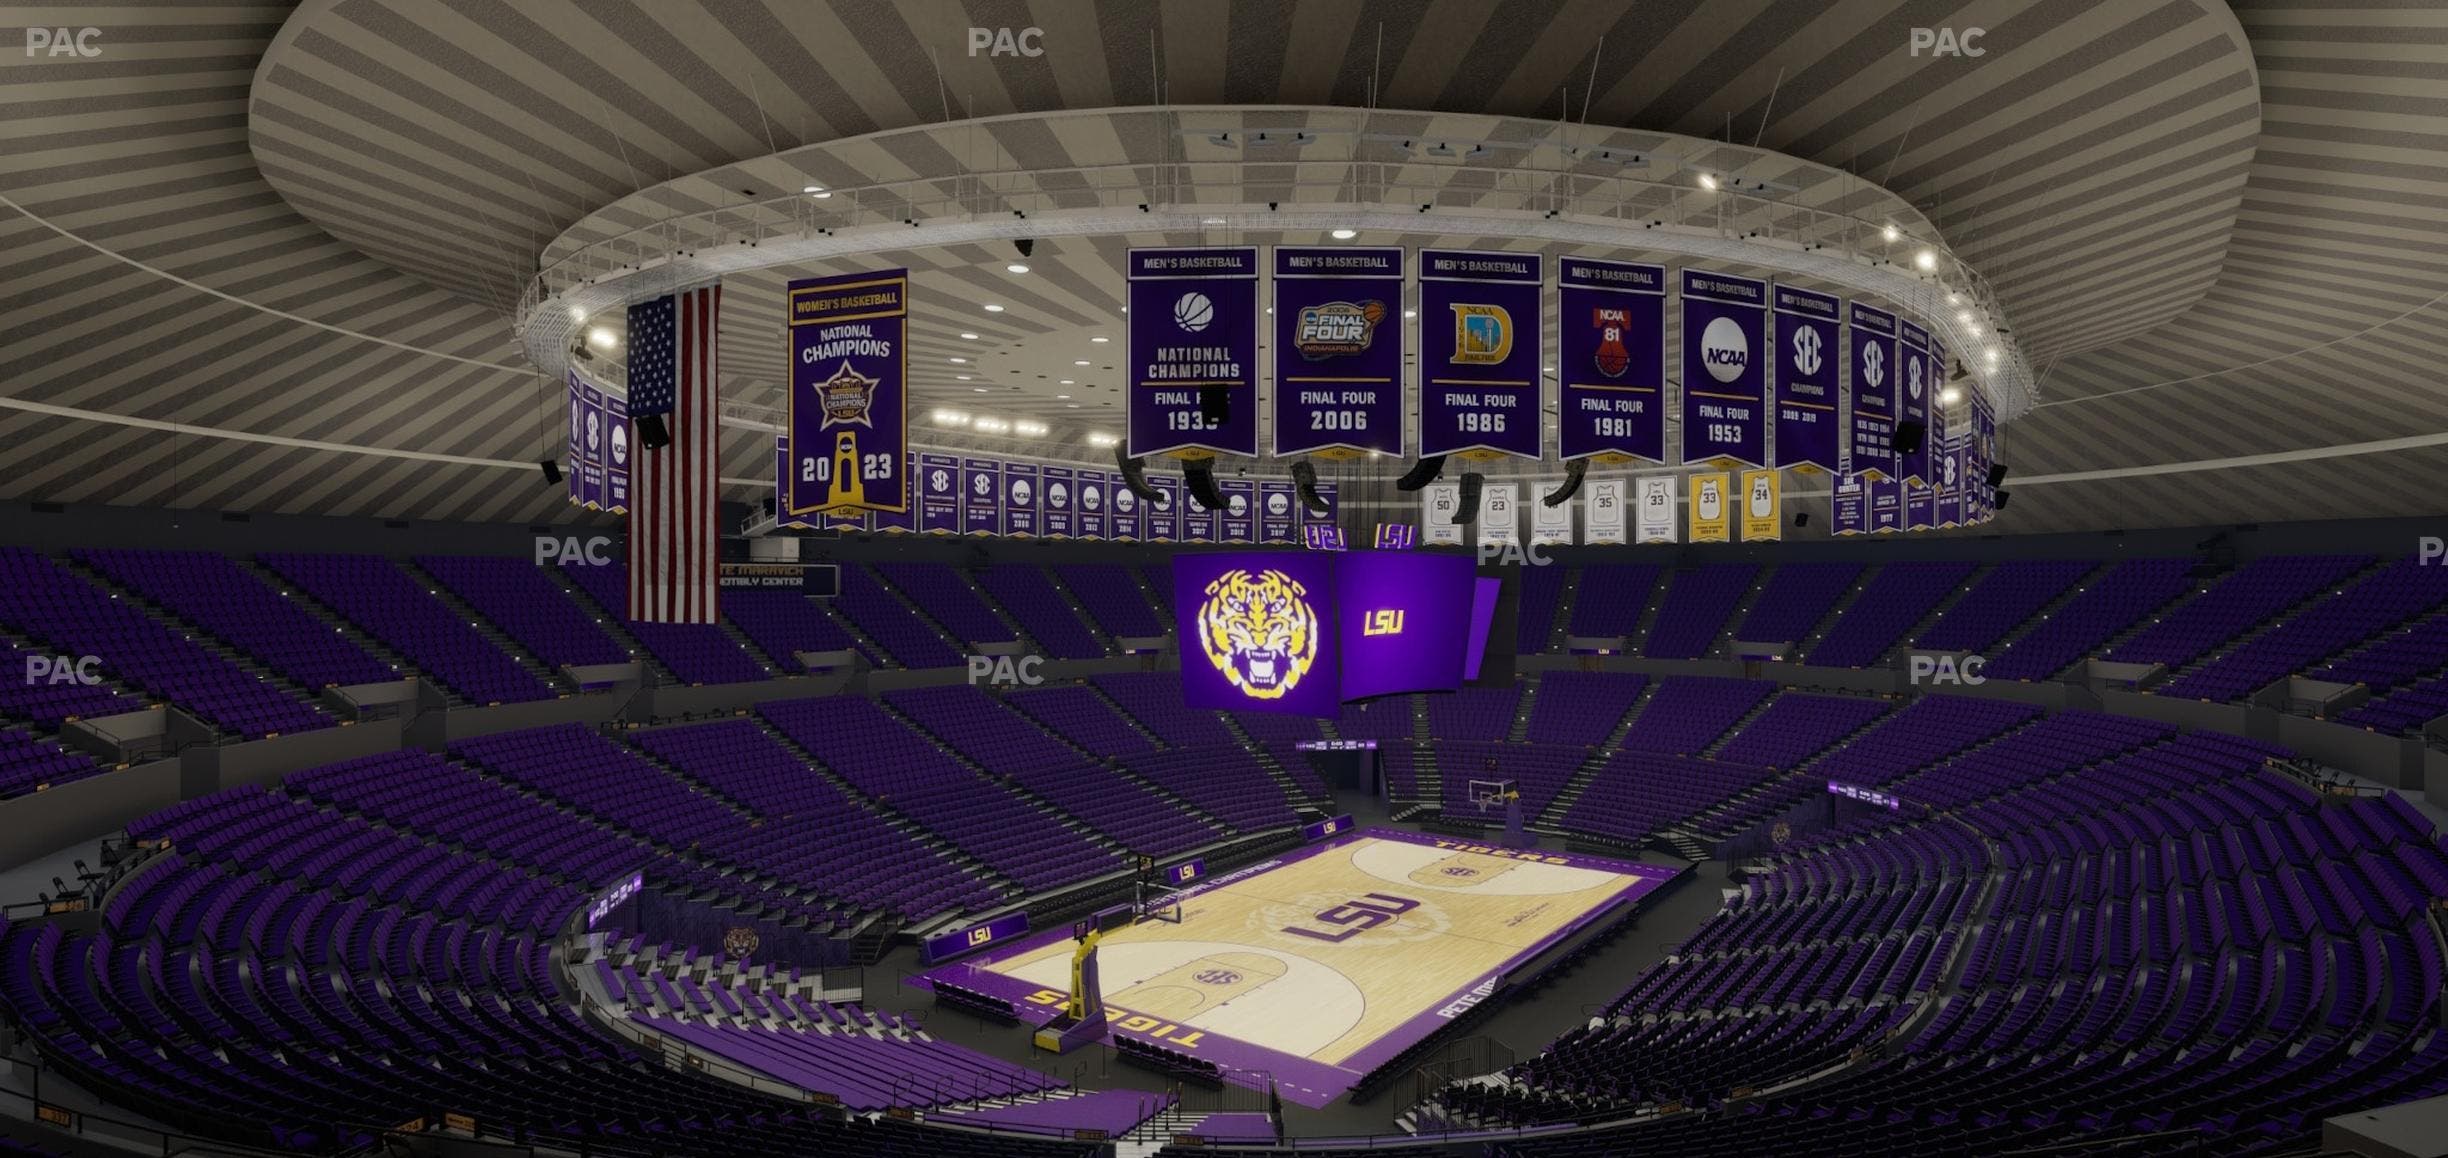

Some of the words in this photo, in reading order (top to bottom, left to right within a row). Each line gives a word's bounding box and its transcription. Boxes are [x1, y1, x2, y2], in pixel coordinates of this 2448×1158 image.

[1144, 258, 1177, 269] MEN'S
[1180, 257, 1242, 268] BASKETBALL
[1290, 256, 1323, 267] MEN'S
[1326, 257, 1388, 268] BASKETBALL
[1435, 259, 1467, 270] MEN'S
[1468, 260, 1528, 274] BASKETBALL
[1572, 267, 1600, 278] MEN'S
[1602, 269, 1653, 284] BASKETBALL
[1692, 278, 1715, 291] MEN'S
[1716, 280, 1757, 297] BASKETBALL
[797, 299, 839, 313] WOMEN'S
[841, 292, 897, 308] BASKETBALL
[1319, 315, 1364, 325] FINAL
[1600, 308, 1624, 321] NCAA
[820, 325, 872, 342] NATIONAL
[1302, 326, 1364, 340] FOUR
[1605, 327, 1619, 342] 81
[803, 340, 891, 364] CHAMPIONS
[1157, 347, 1230, 362] NATIONAL
[1707, 348, 1746, 366] NCAA
[1793, 325, 1822, 376] SEC
[1148, 363, 1240, 378] CHAMPIONS
[1155, 392, 1191, 405] FINAL
[1301, 391, 1336, 404] FINAL
[1342, 391, 1376, 404] FOUR
[1445, 393, 1479, 406] FINAL
[1484, 394, 1516, 407] FOUR
[1581, 398, 1611, 411] FINAL
[1616, 400, 1643, 413] FOUR
[1700, 405, 1723, 418] FINAL
[1727, 407, 1749, 420] FOUR
[1311, 410, 1367, 430] 2006
[1457, 413, 1505, 432] 1986
[1594, 417, 1632, 437] 1981
[1708, 424, 1742, 443] 1953
[802, 457, 829, 481] 20
[864, 453, 892, 480] 23
[932, 469, 949, 492] SEC
[974, 473, 990, 495] SEC
[1650, 495, 1663, 505] 33
[1703, 492, 1716, 503] 33
[1755, 489, 1768, 500] 34
[1437, 501, 1450, 510] 50
[1492, 501, 1505, 511] 23
[1599, 497, 1612, 508] 35
[1375, 523, 1417, 549] LSU
[738, 566, 804, 575] MARAVICH
[720, 577, 759, 586] EMBLY
[762, 577, 804, 586] CENTER
[1364, 610, 1404, 636] LSU
[1323, 821, 1336, 834] LSU
[1436, 840, 1570, 864] TIGERS
[1179, 864, 1195, 880] LSU
[1280, 893, 1420, 943] LSU
[968, 926, 991, 947] LSU
[1436, 994, 1485, 1019] PETE
[1024, 990, 1205, 1048] TIGES
